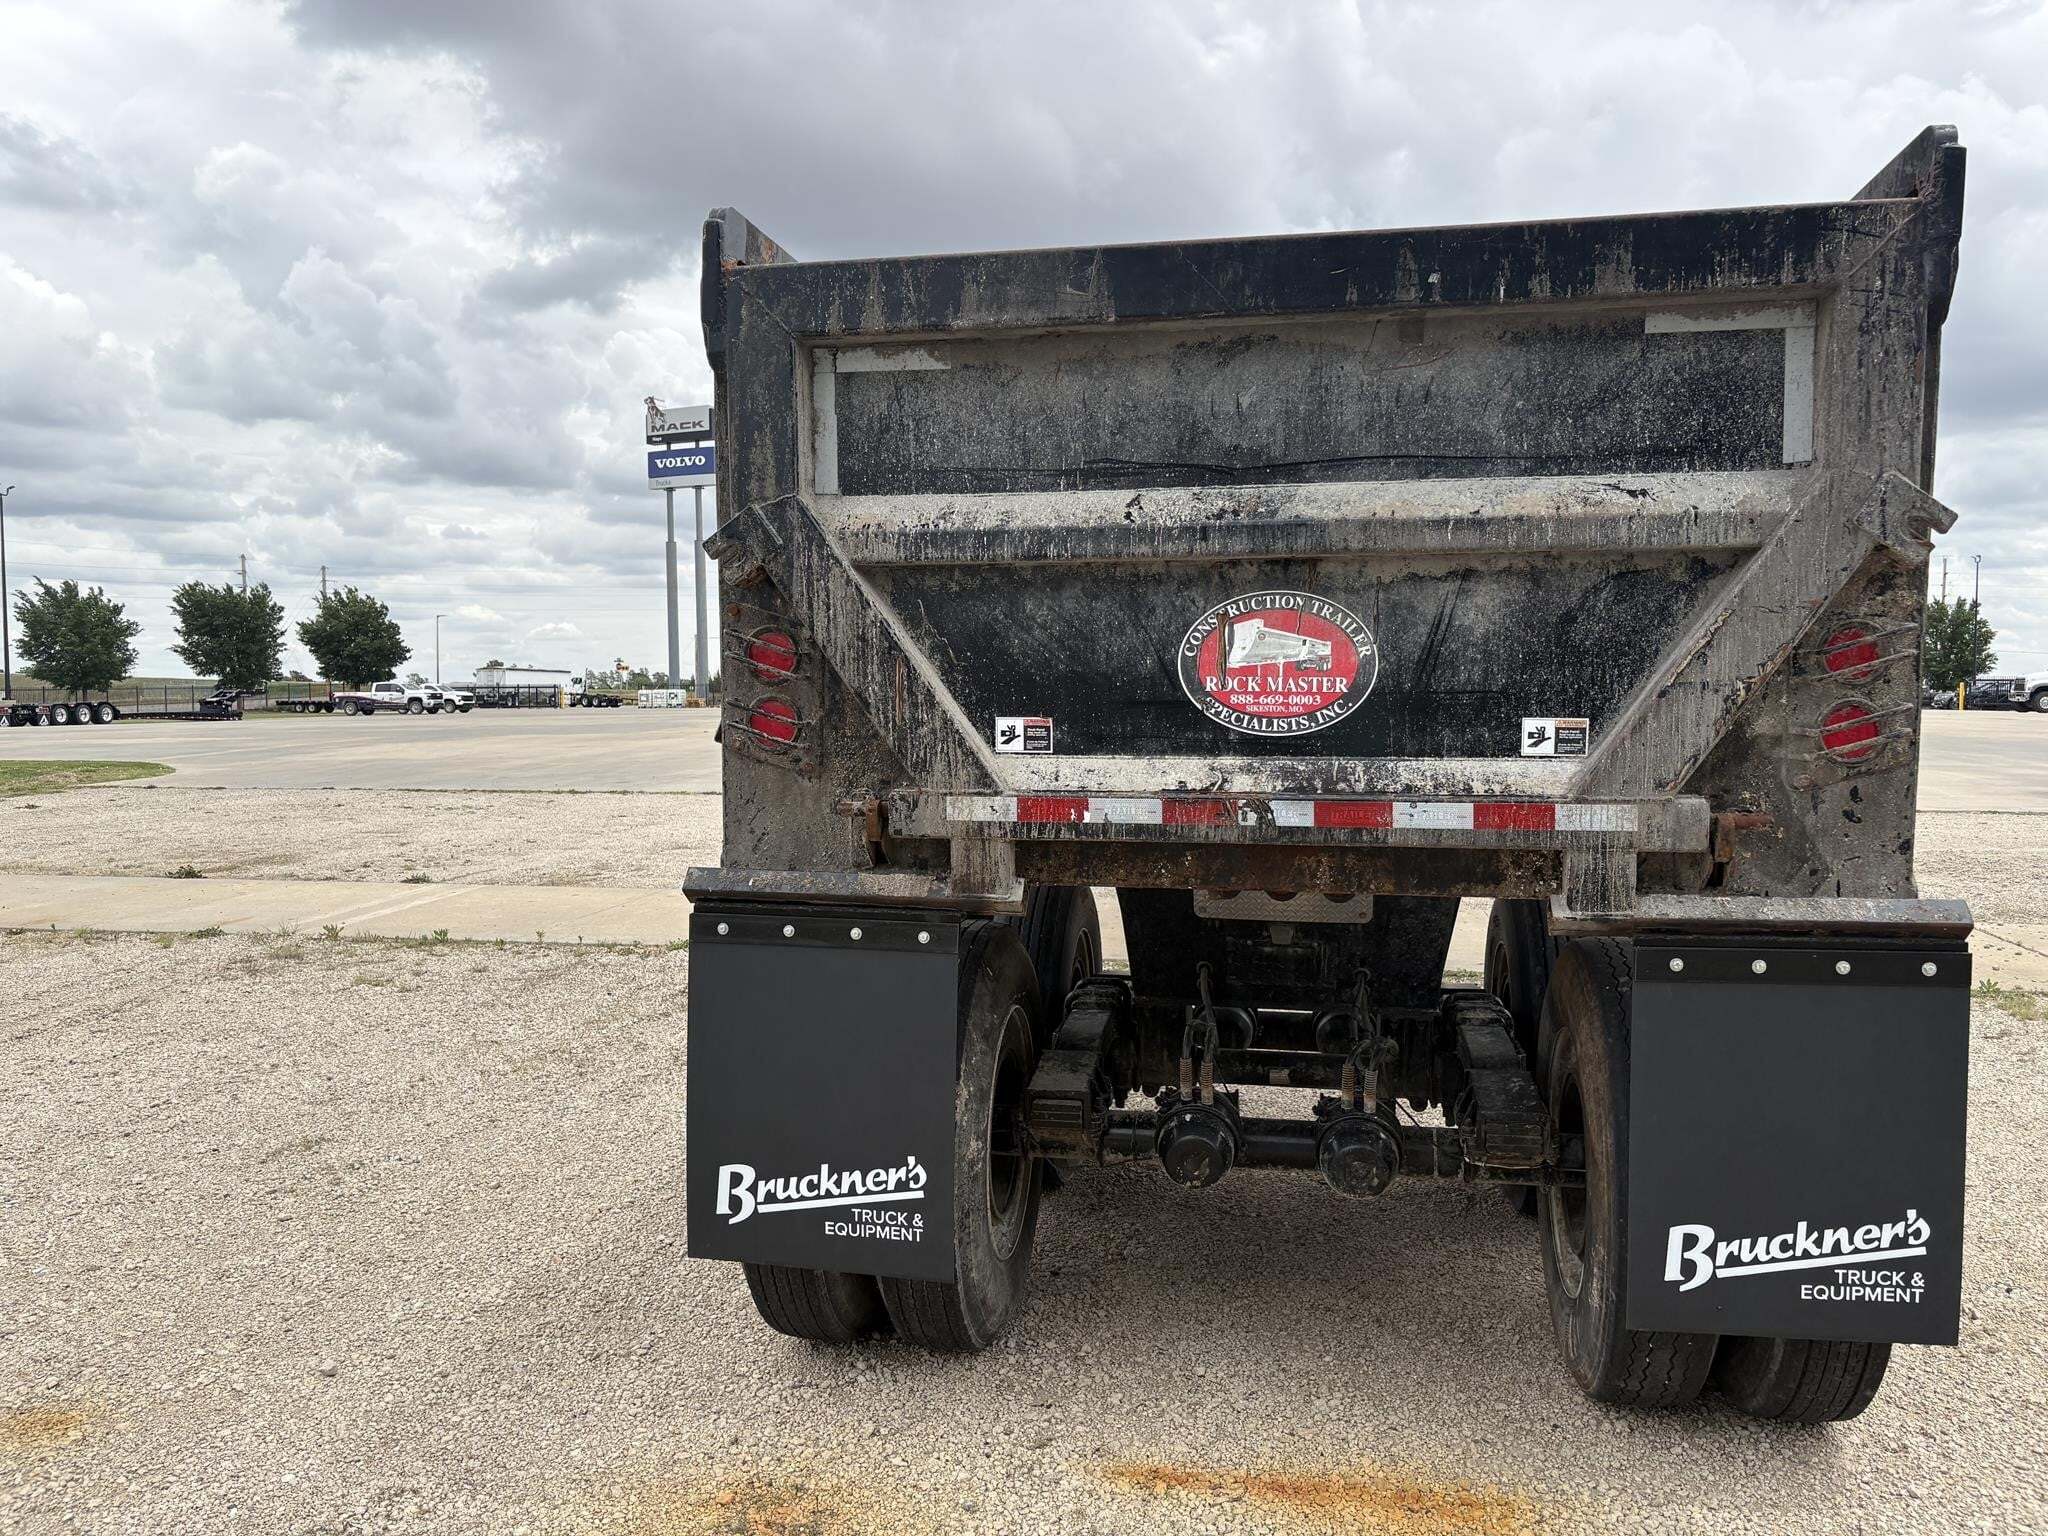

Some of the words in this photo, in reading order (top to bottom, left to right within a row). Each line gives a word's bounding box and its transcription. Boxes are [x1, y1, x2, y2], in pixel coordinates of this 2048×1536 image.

[651, 420, 704, 432] MACK
[655, 455, 706, 468] VOLVO
[1184, 595, 1306, 656] CONSRUCTION
[1311, 600, 1372, 658] TRAILER
[1205, 675, 1261, 692] ROCK
[1266, 675, 1349, 693] MASTER
[1230, 694, 1321, 705] 888-669-0003
[1315, 699, 1352, 724] INC.
[716, 1155, 927, 1225] Bruckner's
[851, 1208, 908, 1226] TRUCK
[912, 1213, 924, 1228] &
[825, 1221, 924, 1243] EQUIPMENT
[1664, 1208, 1931, 1292] Bruckner's
[1834, 1269, 1906, 1287] TRUCK
[1911, 1271, 1925, 1288] &
[1800, 1284, 1925, 1304] EQUIPMENT
